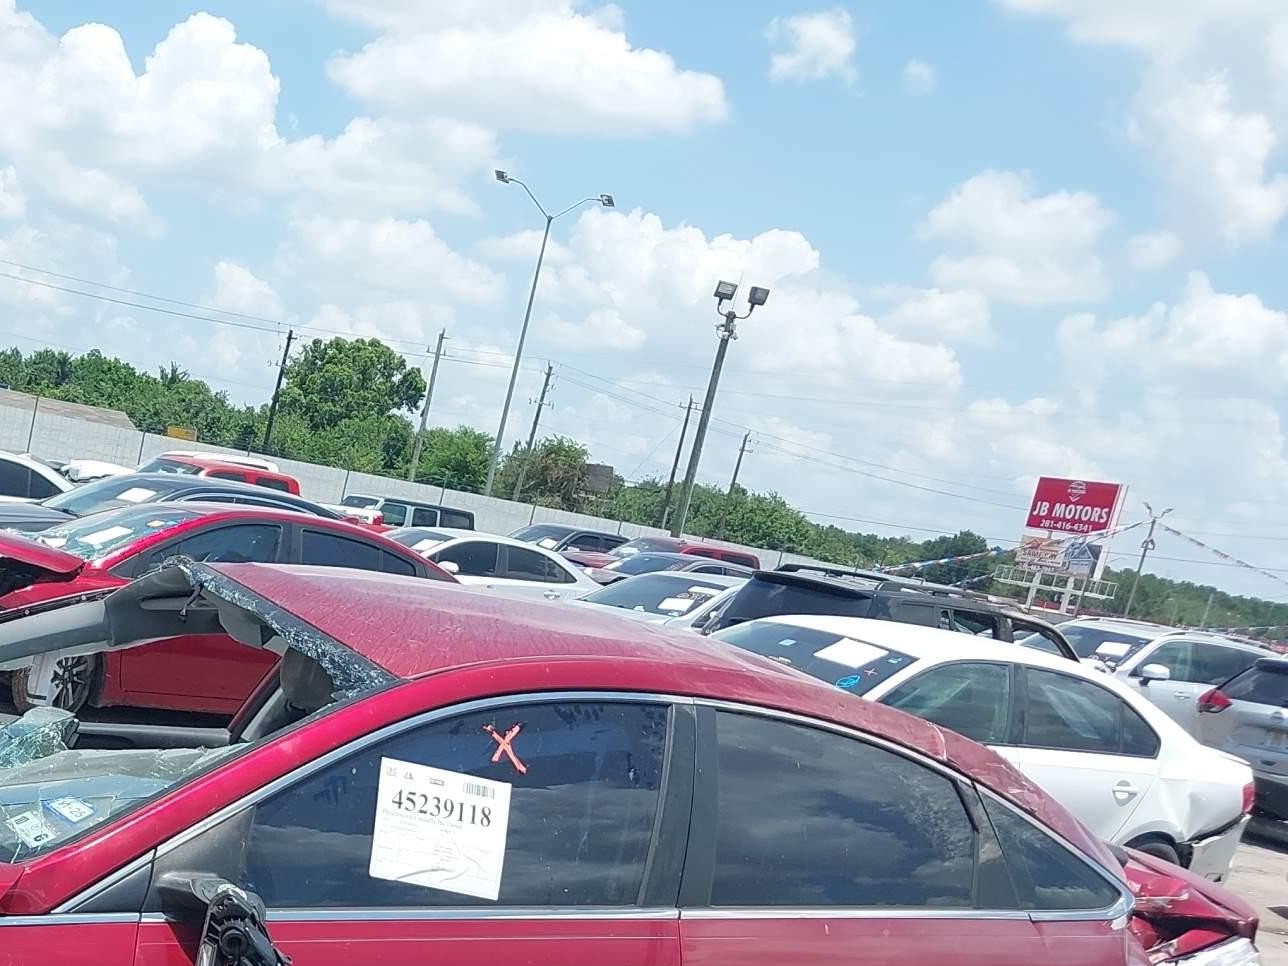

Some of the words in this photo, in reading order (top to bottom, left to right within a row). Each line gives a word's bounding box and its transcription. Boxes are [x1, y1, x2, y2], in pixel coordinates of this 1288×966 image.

[1032, 500, 1050, 516] JB
[1051, 502, 1110, 523] MOTORS
[1039, 519, 1092, 532] 281-416-4341
[391, 788, 492, 828] 45239118
